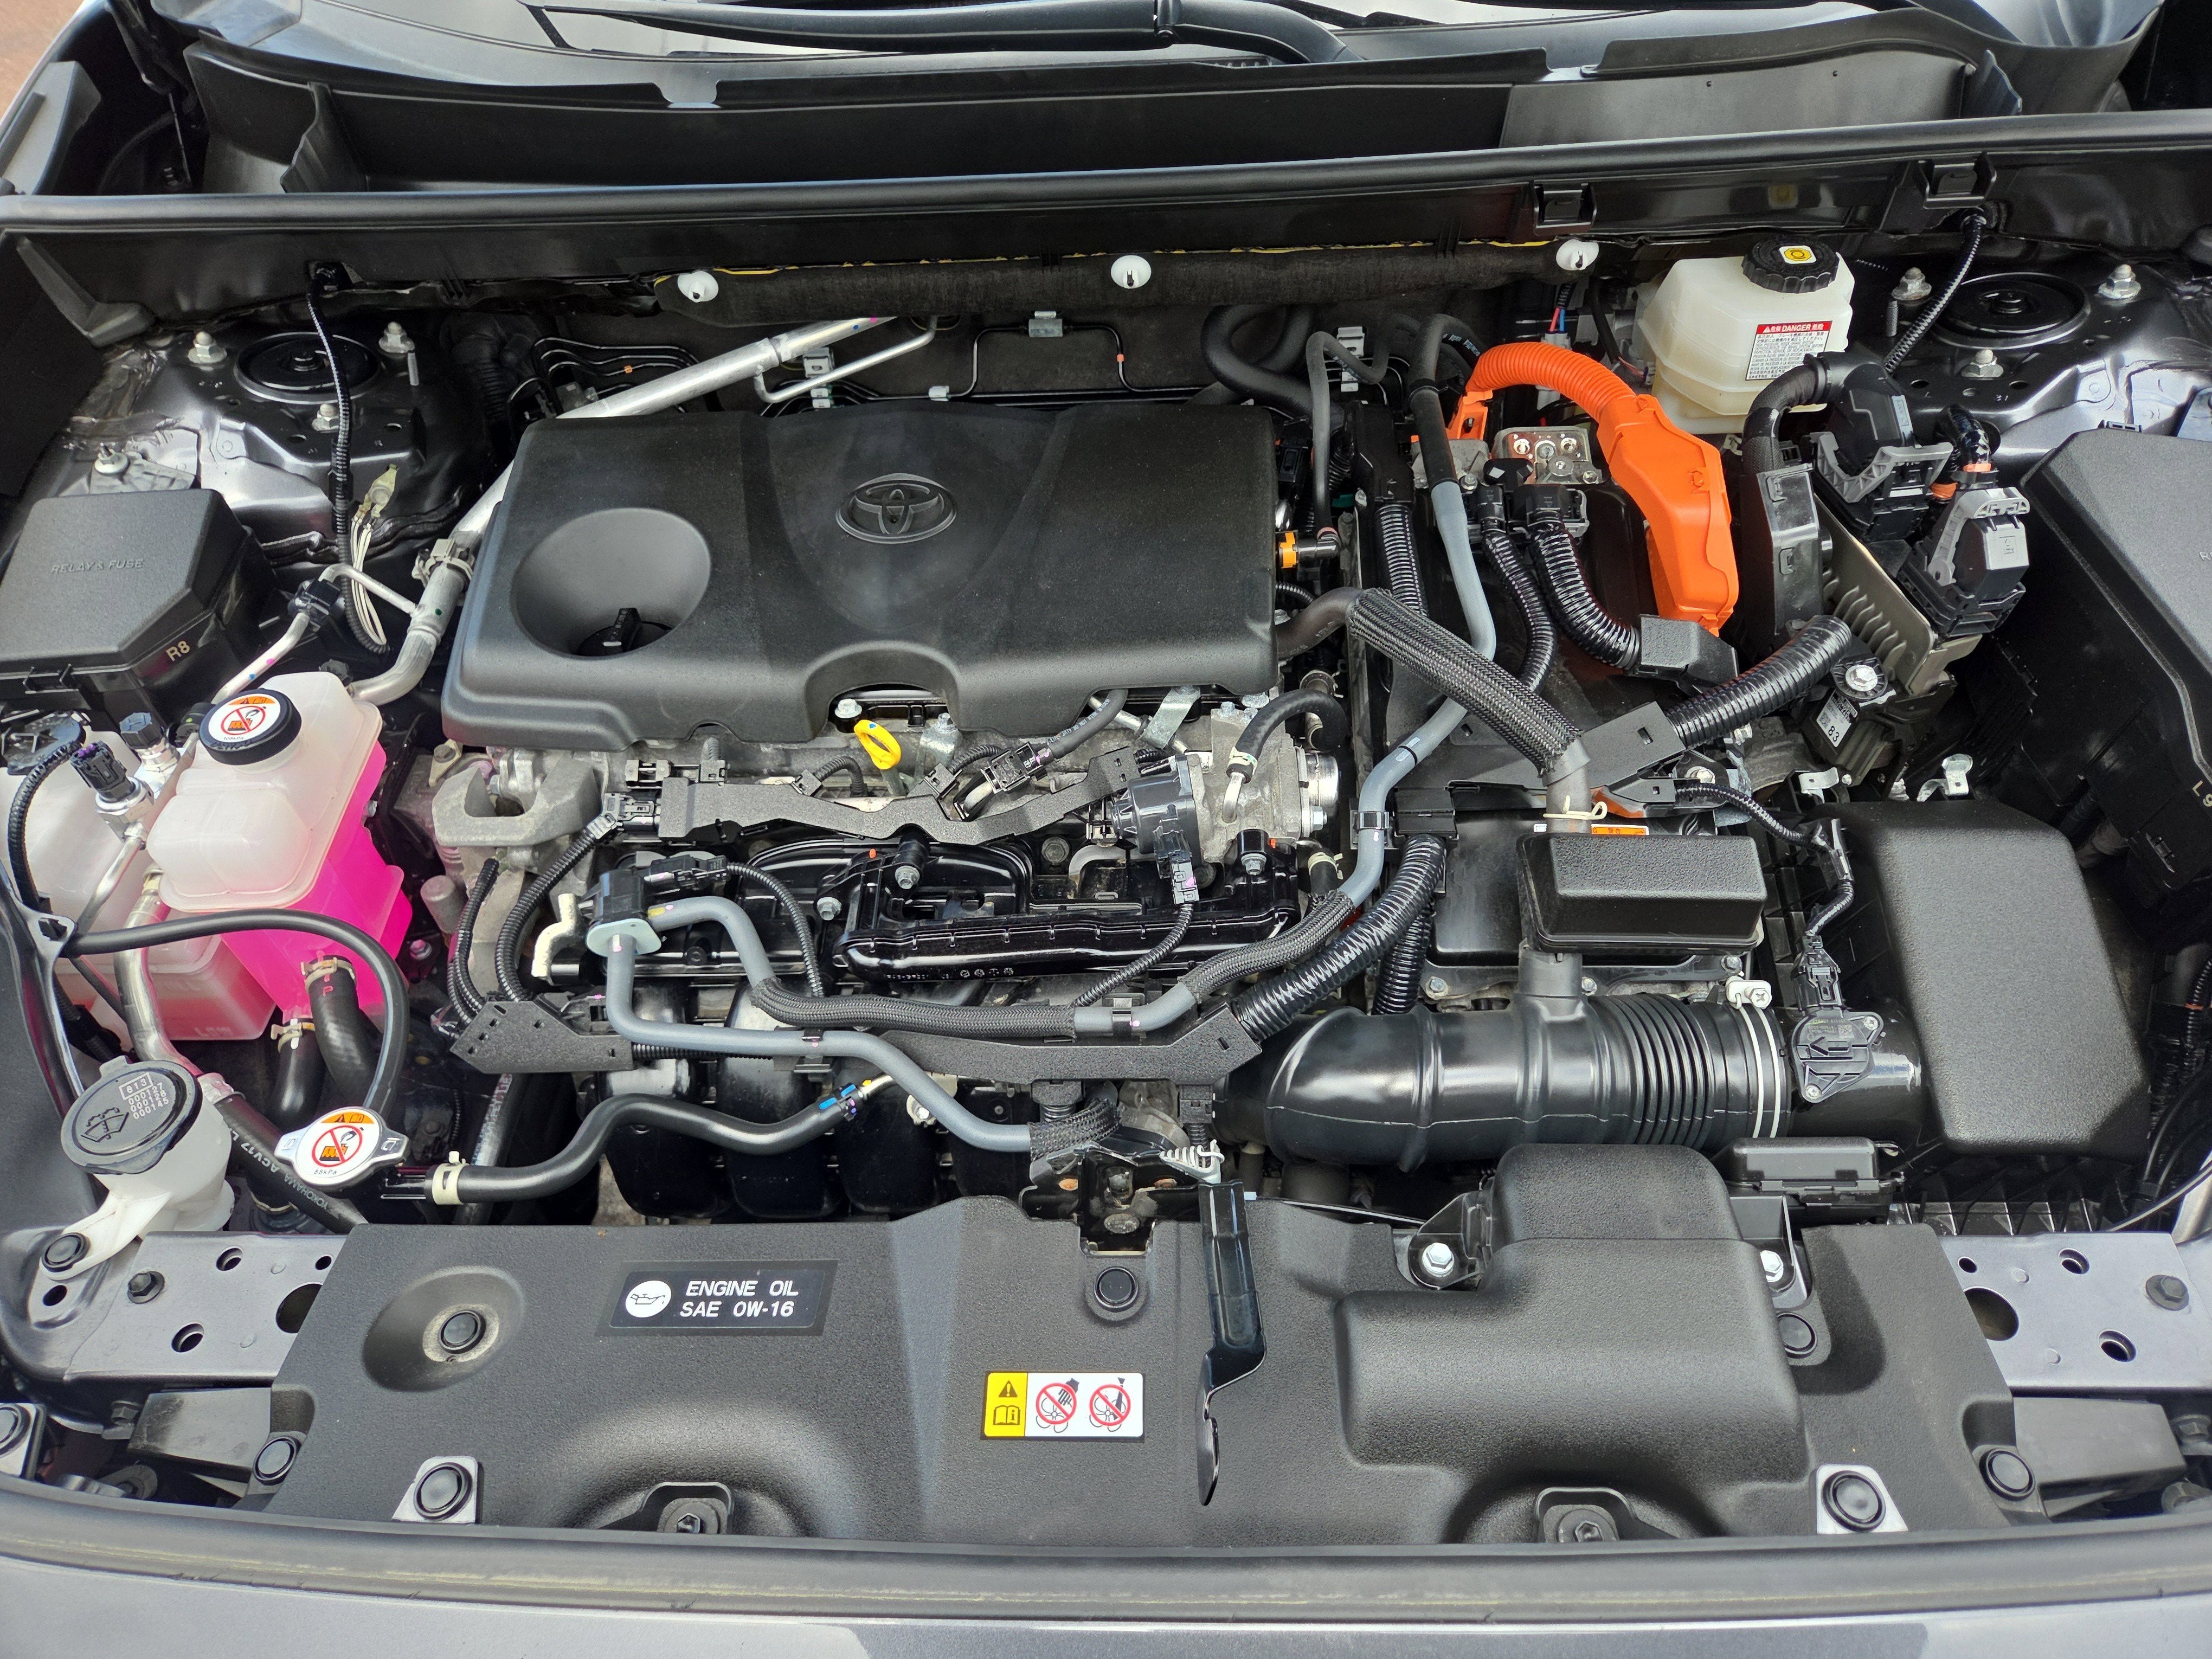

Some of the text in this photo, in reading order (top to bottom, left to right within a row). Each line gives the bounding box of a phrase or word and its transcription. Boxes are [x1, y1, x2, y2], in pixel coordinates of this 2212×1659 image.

[1782, 324, 1811, 332] DANGER
[51, 558, 144, 574] RELAY & FUSE
[165, 640, 190, 662] R8
[1828, 725, 1840, 742] 83
[128, 1082, 163, 1105] 000127
[241, 1142, 281, 1173] ACV17
[284, 1173, 329, 1210] YOKOHAMA
[685, 1280, 799, 1296] ENGINE OIL
[679, 1301, 795, 1317] SAE 0W-16
